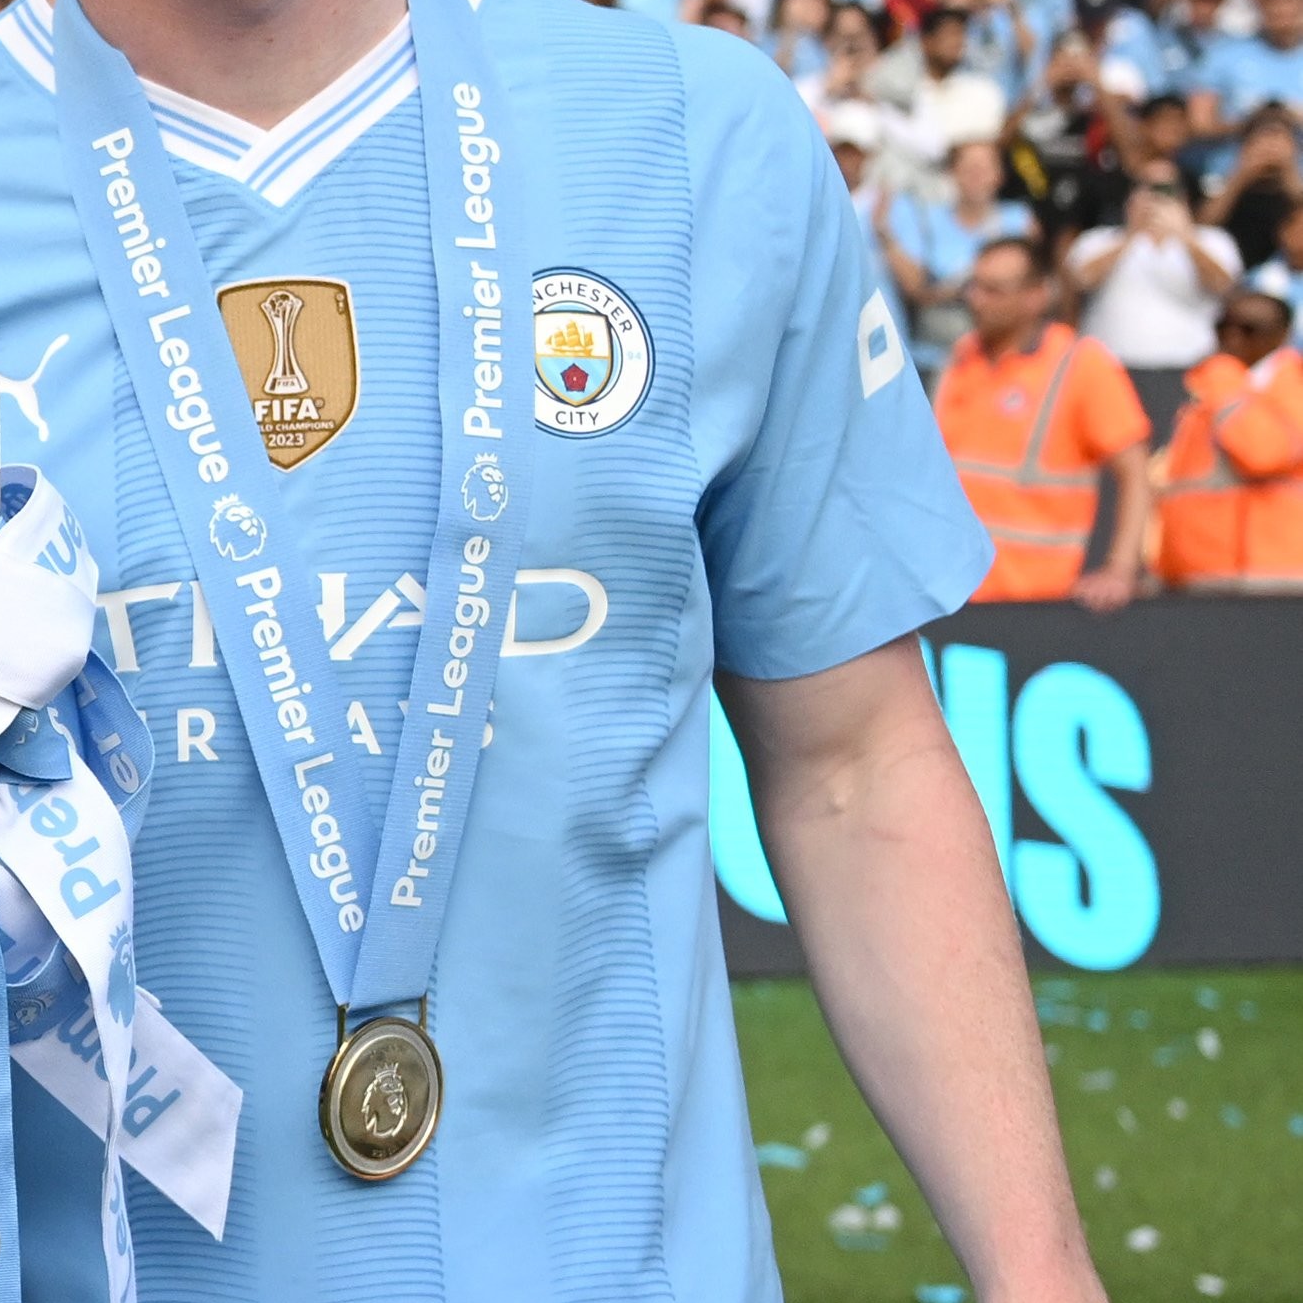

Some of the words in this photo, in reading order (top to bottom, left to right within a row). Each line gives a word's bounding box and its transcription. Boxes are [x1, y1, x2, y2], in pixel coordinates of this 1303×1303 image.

[455, 82, 500, 249] League
[92, 126, 170, 298] Premier
[147, 305, 228, 483] League
[463, 261, 503, 439] Premier
[532, 282, 633, 333] NCHESTER
[254, 398, 320, 422] FIFA
[267, 433, 305, 447] 2023
[555, 411, 599, 426] CITY
[235, 565, 316, 745] Premier
[294, 753, 364, 933] League
[390, 728, 454, 907] Premier
[426, 535, 491, 717] League
[30, 795, 122, 919] Pre
